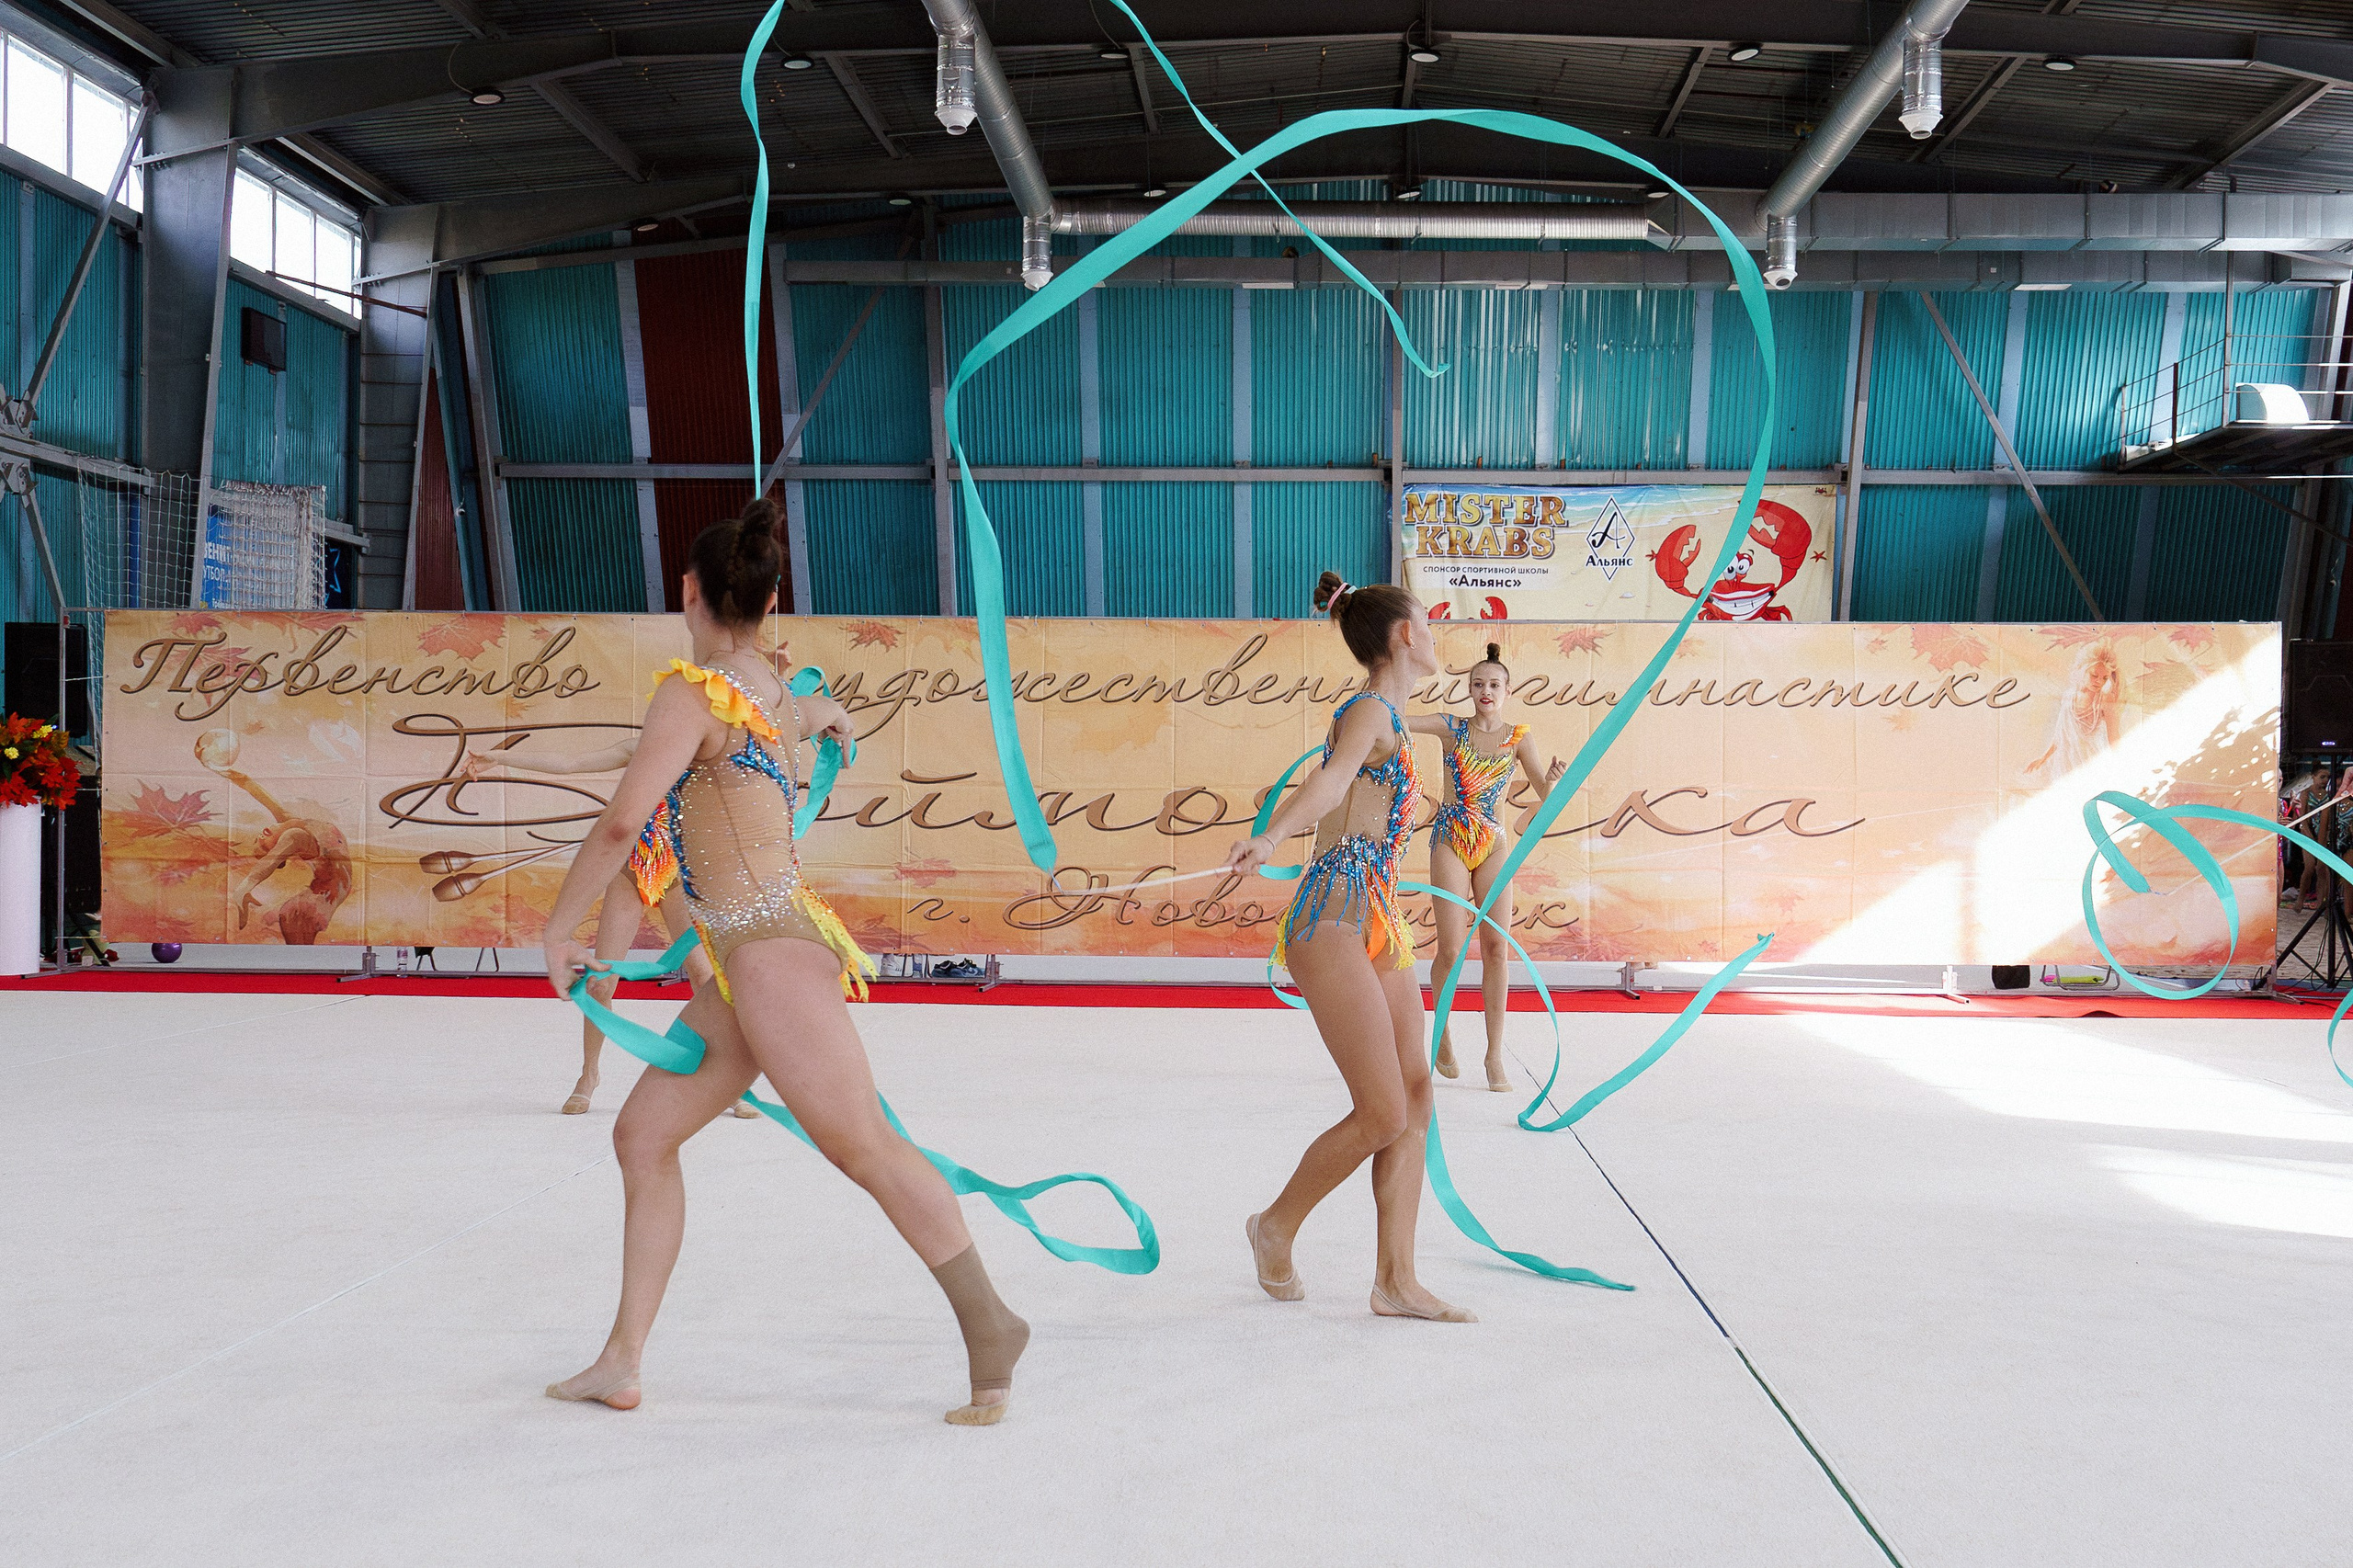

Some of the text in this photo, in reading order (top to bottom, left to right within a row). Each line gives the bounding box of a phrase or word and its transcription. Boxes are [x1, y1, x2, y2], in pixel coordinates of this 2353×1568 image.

[1404, 493, 1569, 527] MISTER
[1415, 525, 1556, 560] KRABS
[1461, 565, 1516, 574] СПОРТИВНОЙ
[1518, 566, 1549, 574] ШКОЛЫ
[1586, 554, 1633, 567] Альянс
[1449, 574, 1522, 588] «Альянс»
[120, 624, 602, 722] Первенство
[790, 632, 1474, 742] удожественнй
[906, 897, 971, 924] г.
